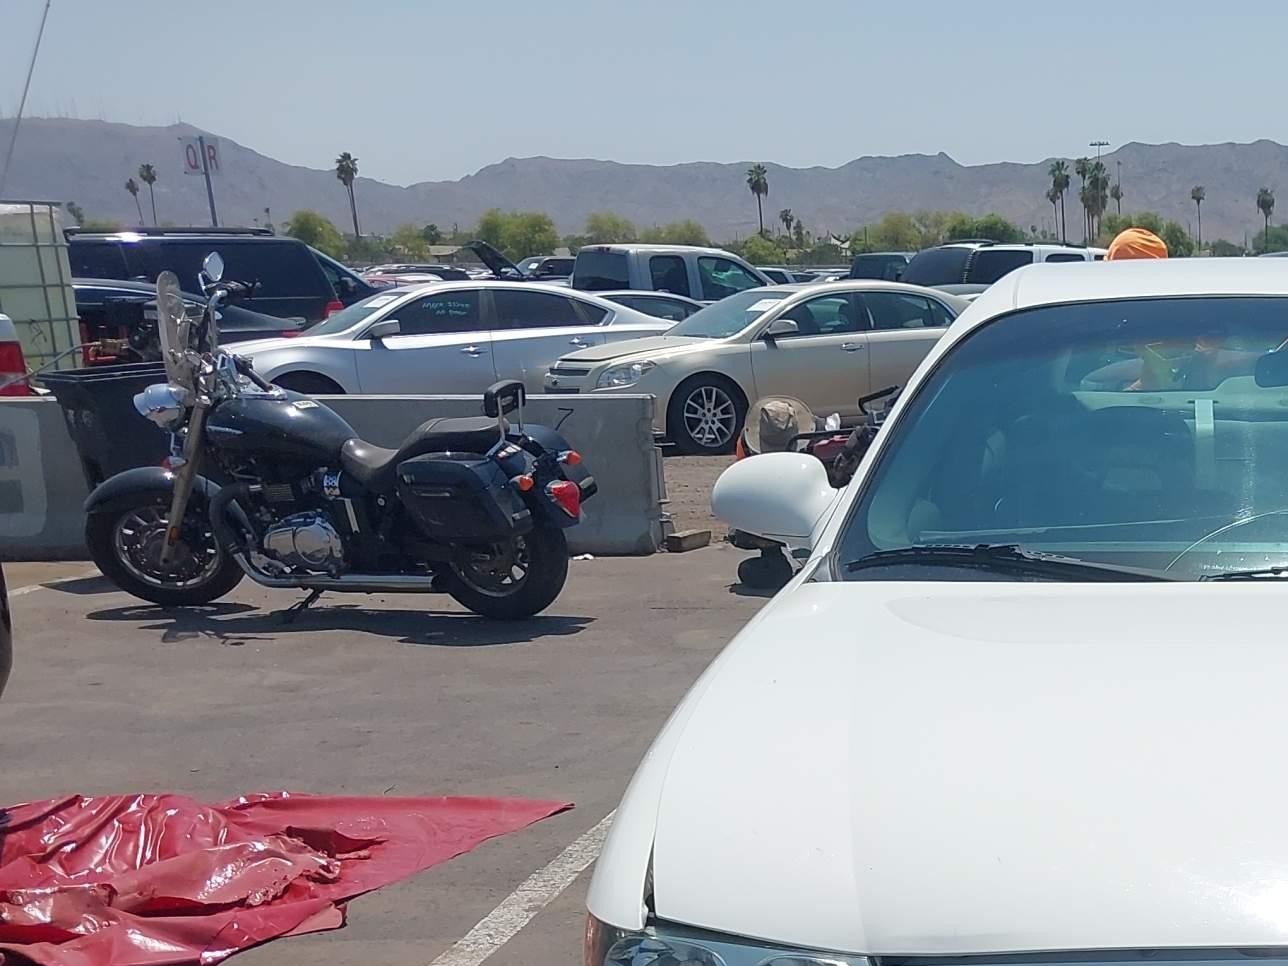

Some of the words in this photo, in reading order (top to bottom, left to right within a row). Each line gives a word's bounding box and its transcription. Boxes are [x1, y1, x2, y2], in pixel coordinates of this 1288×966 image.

[186, 143, 200, 170] Q
[207, 144, 219, 170] R
[554, 407, 575, 431] 7
